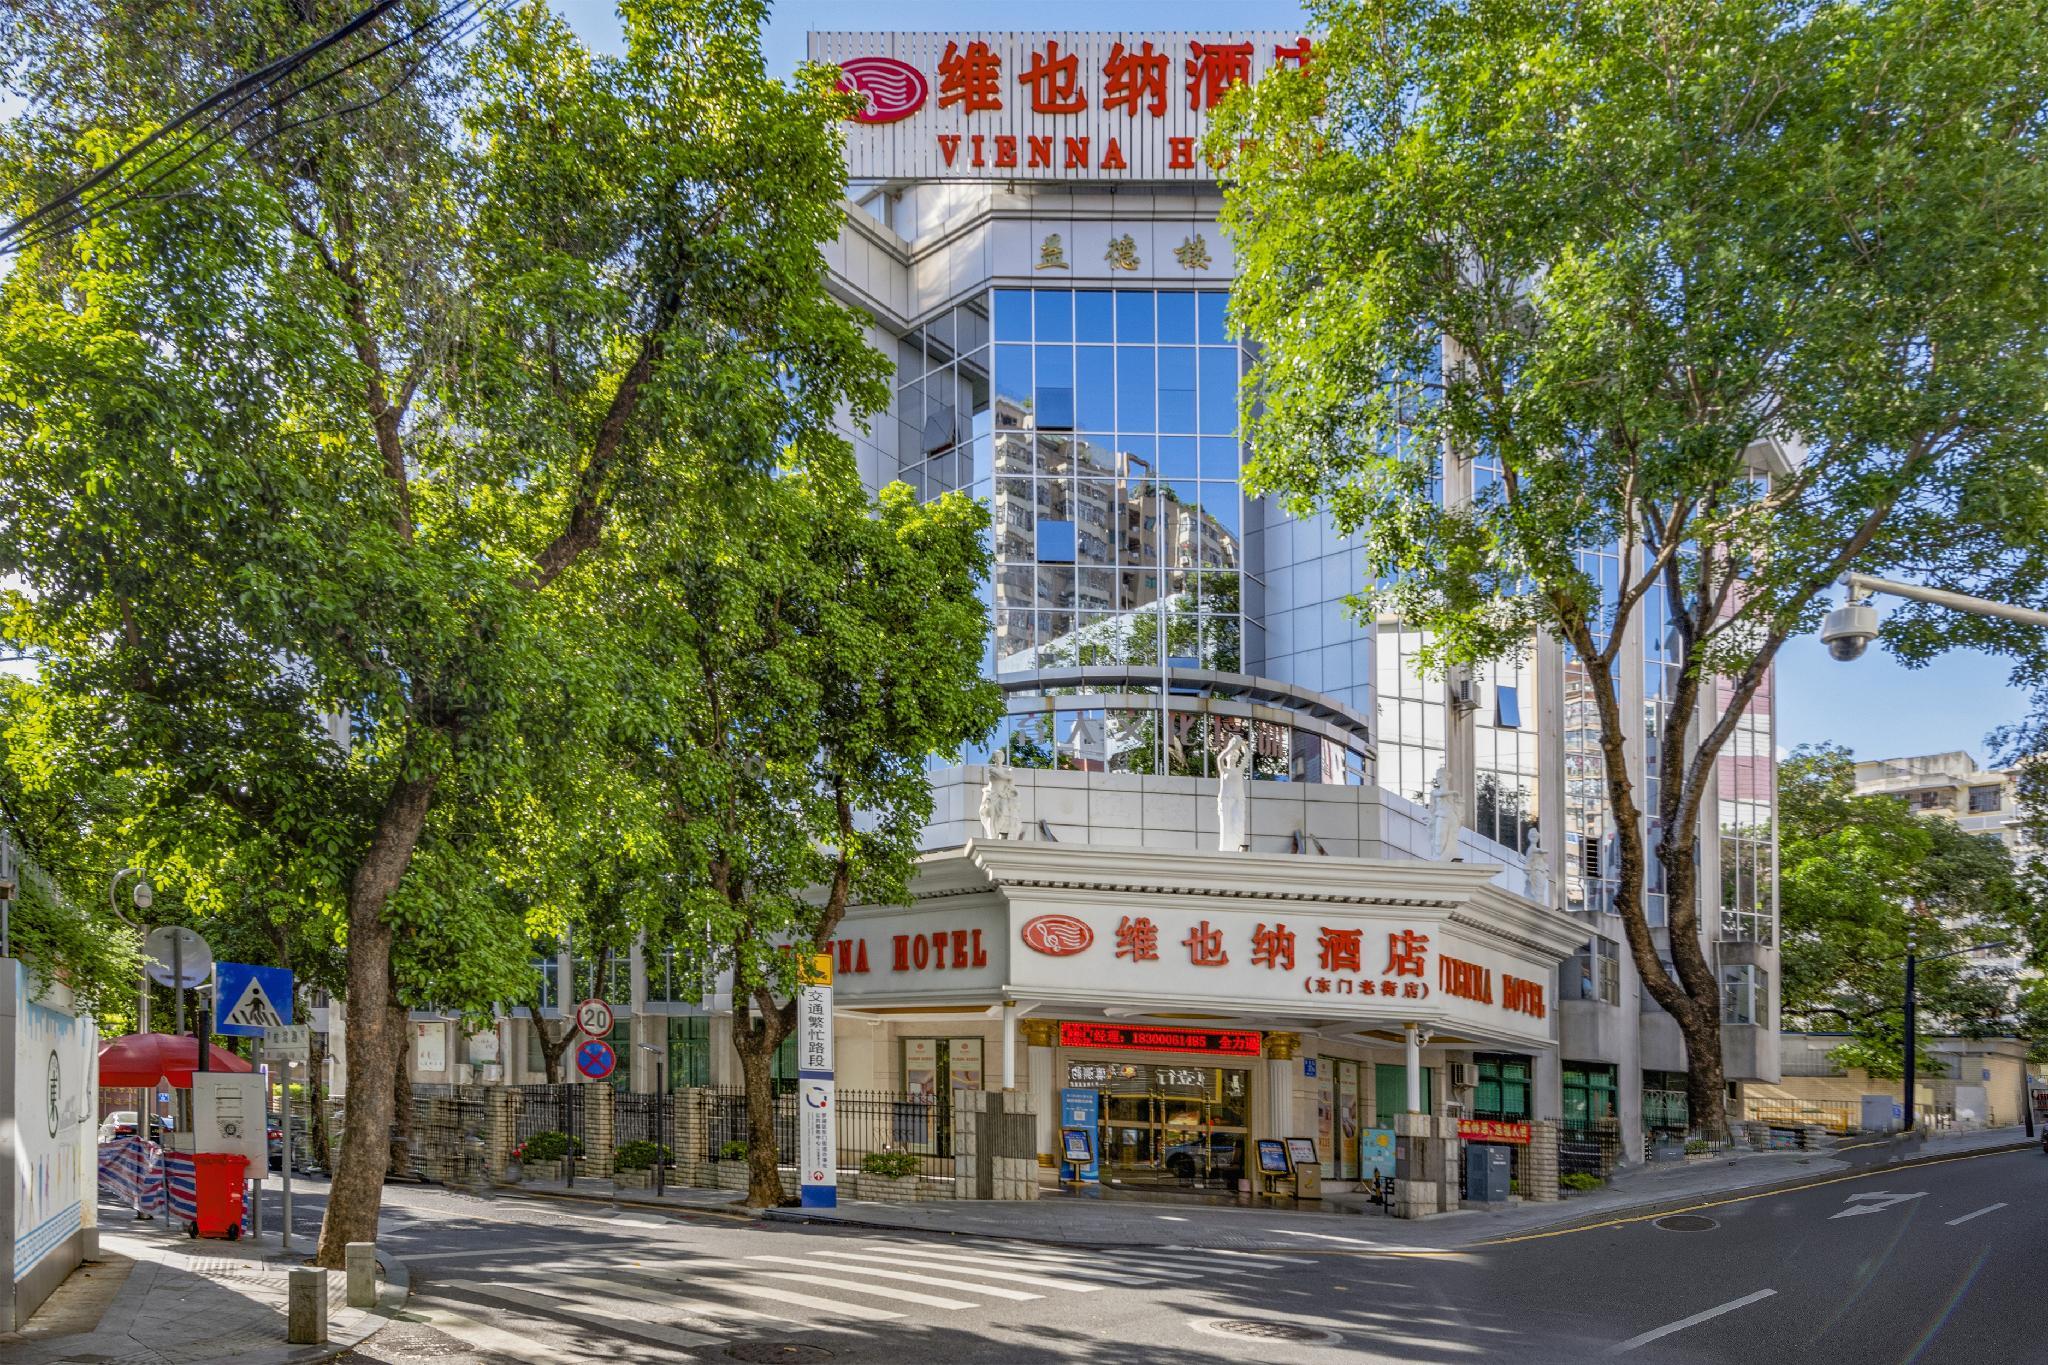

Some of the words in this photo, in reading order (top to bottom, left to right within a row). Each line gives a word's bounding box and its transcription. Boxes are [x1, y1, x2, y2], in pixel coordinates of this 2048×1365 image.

[937, 37, 1326, 118] 维也纳酒
[937, 134, 1127, 169] VIENNA
[892, 929, 987, 972] HOTEL
[1114, 915, 1431, 978] 维也纳酒店
[1304, 976, 1430, 1000] (东门老街店)
[1502, 974, 1546, 1020] HOTEL
[584, 1008, 606, 1029] 20
[808, 990, 825, 1067] 交通繁忙路段
